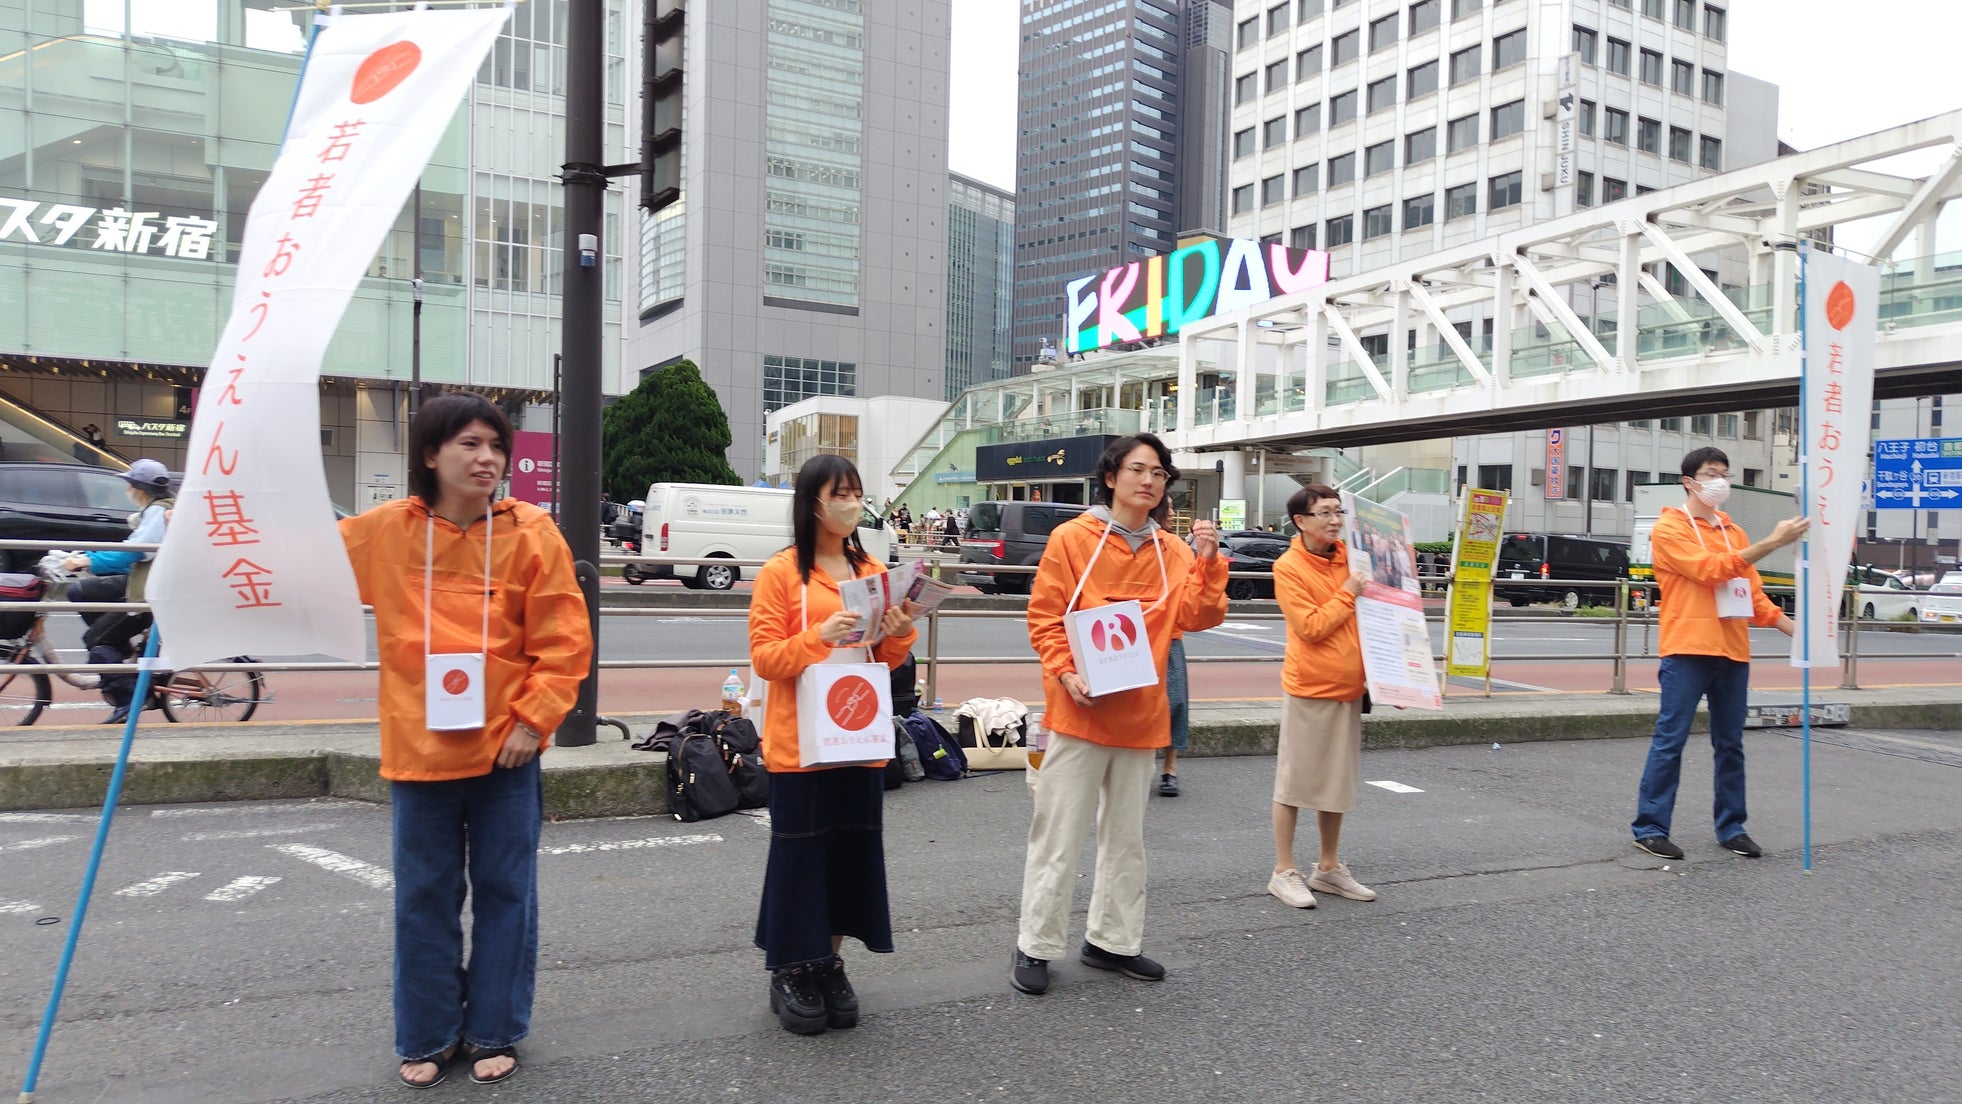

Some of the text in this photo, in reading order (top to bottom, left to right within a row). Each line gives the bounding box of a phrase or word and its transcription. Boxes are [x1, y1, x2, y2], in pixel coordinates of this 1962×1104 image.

[202, 119, 366, 609] 若者おうえん基金
[1878, 442, 1910, 453] 八王子
